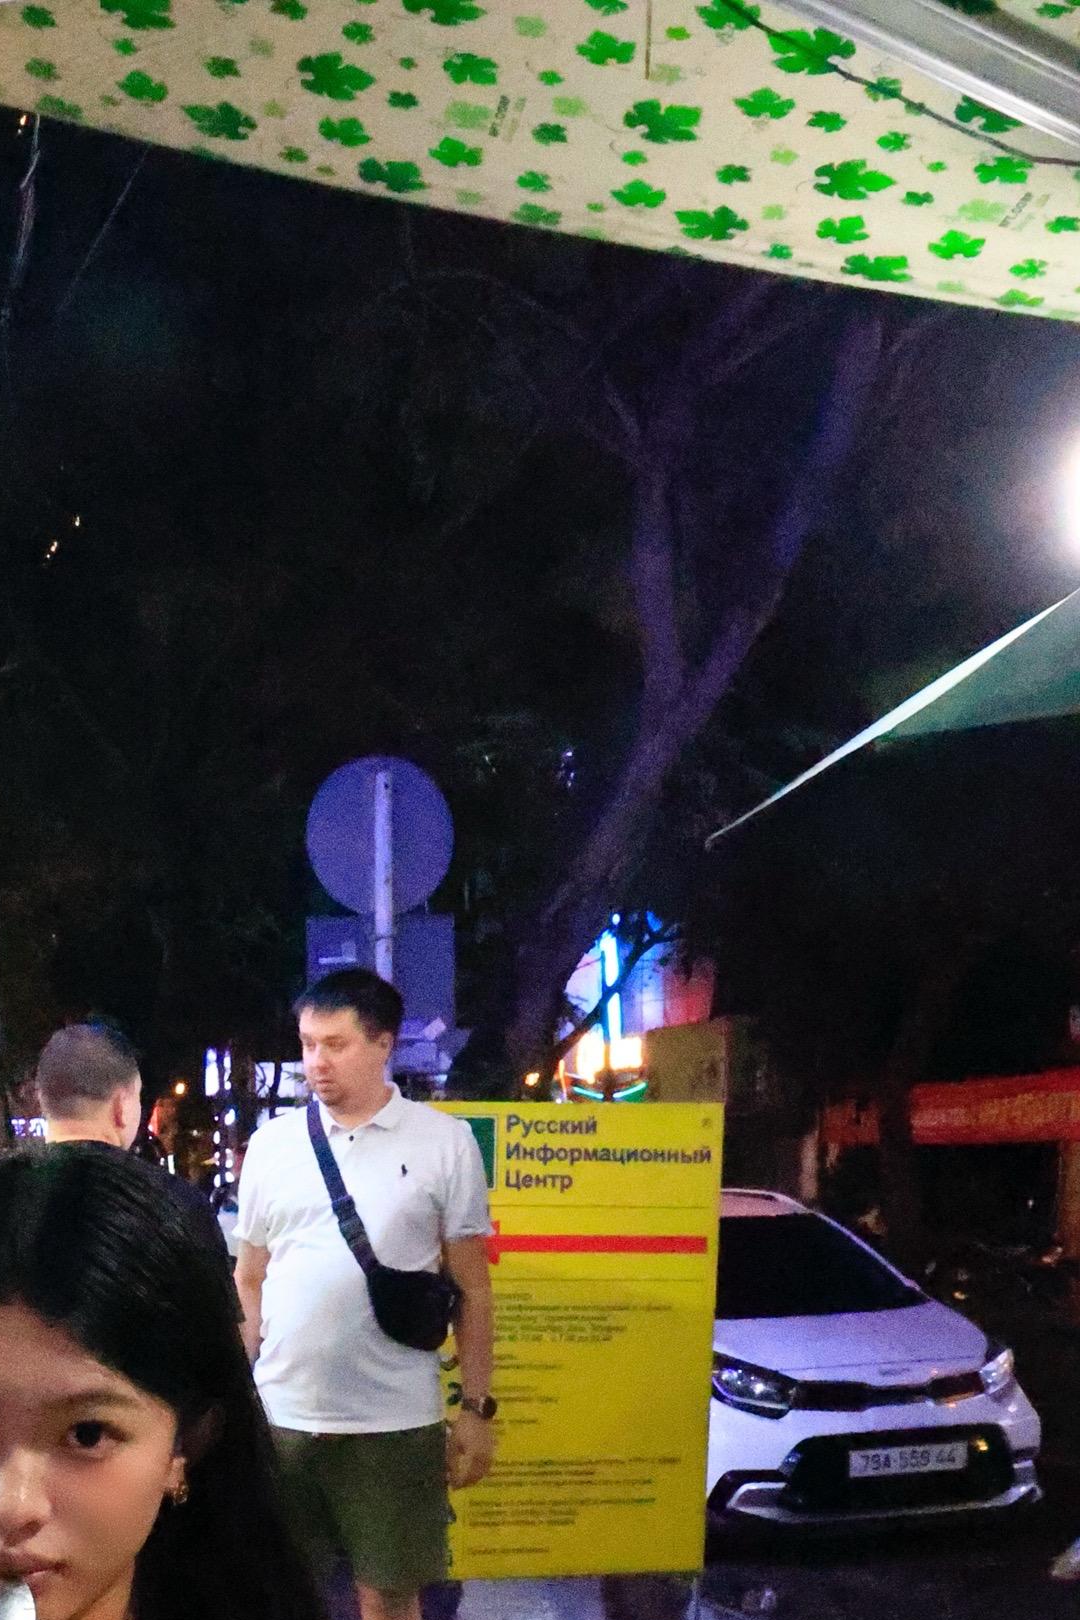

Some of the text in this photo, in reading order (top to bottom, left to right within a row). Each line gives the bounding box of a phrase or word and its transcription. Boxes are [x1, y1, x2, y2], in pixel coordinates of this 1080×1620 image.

[505, 1113, 598, 1137] Русский
[505, 1142, 712, 1165] Информационный
[505, 1169, 573, 1193] Центр
